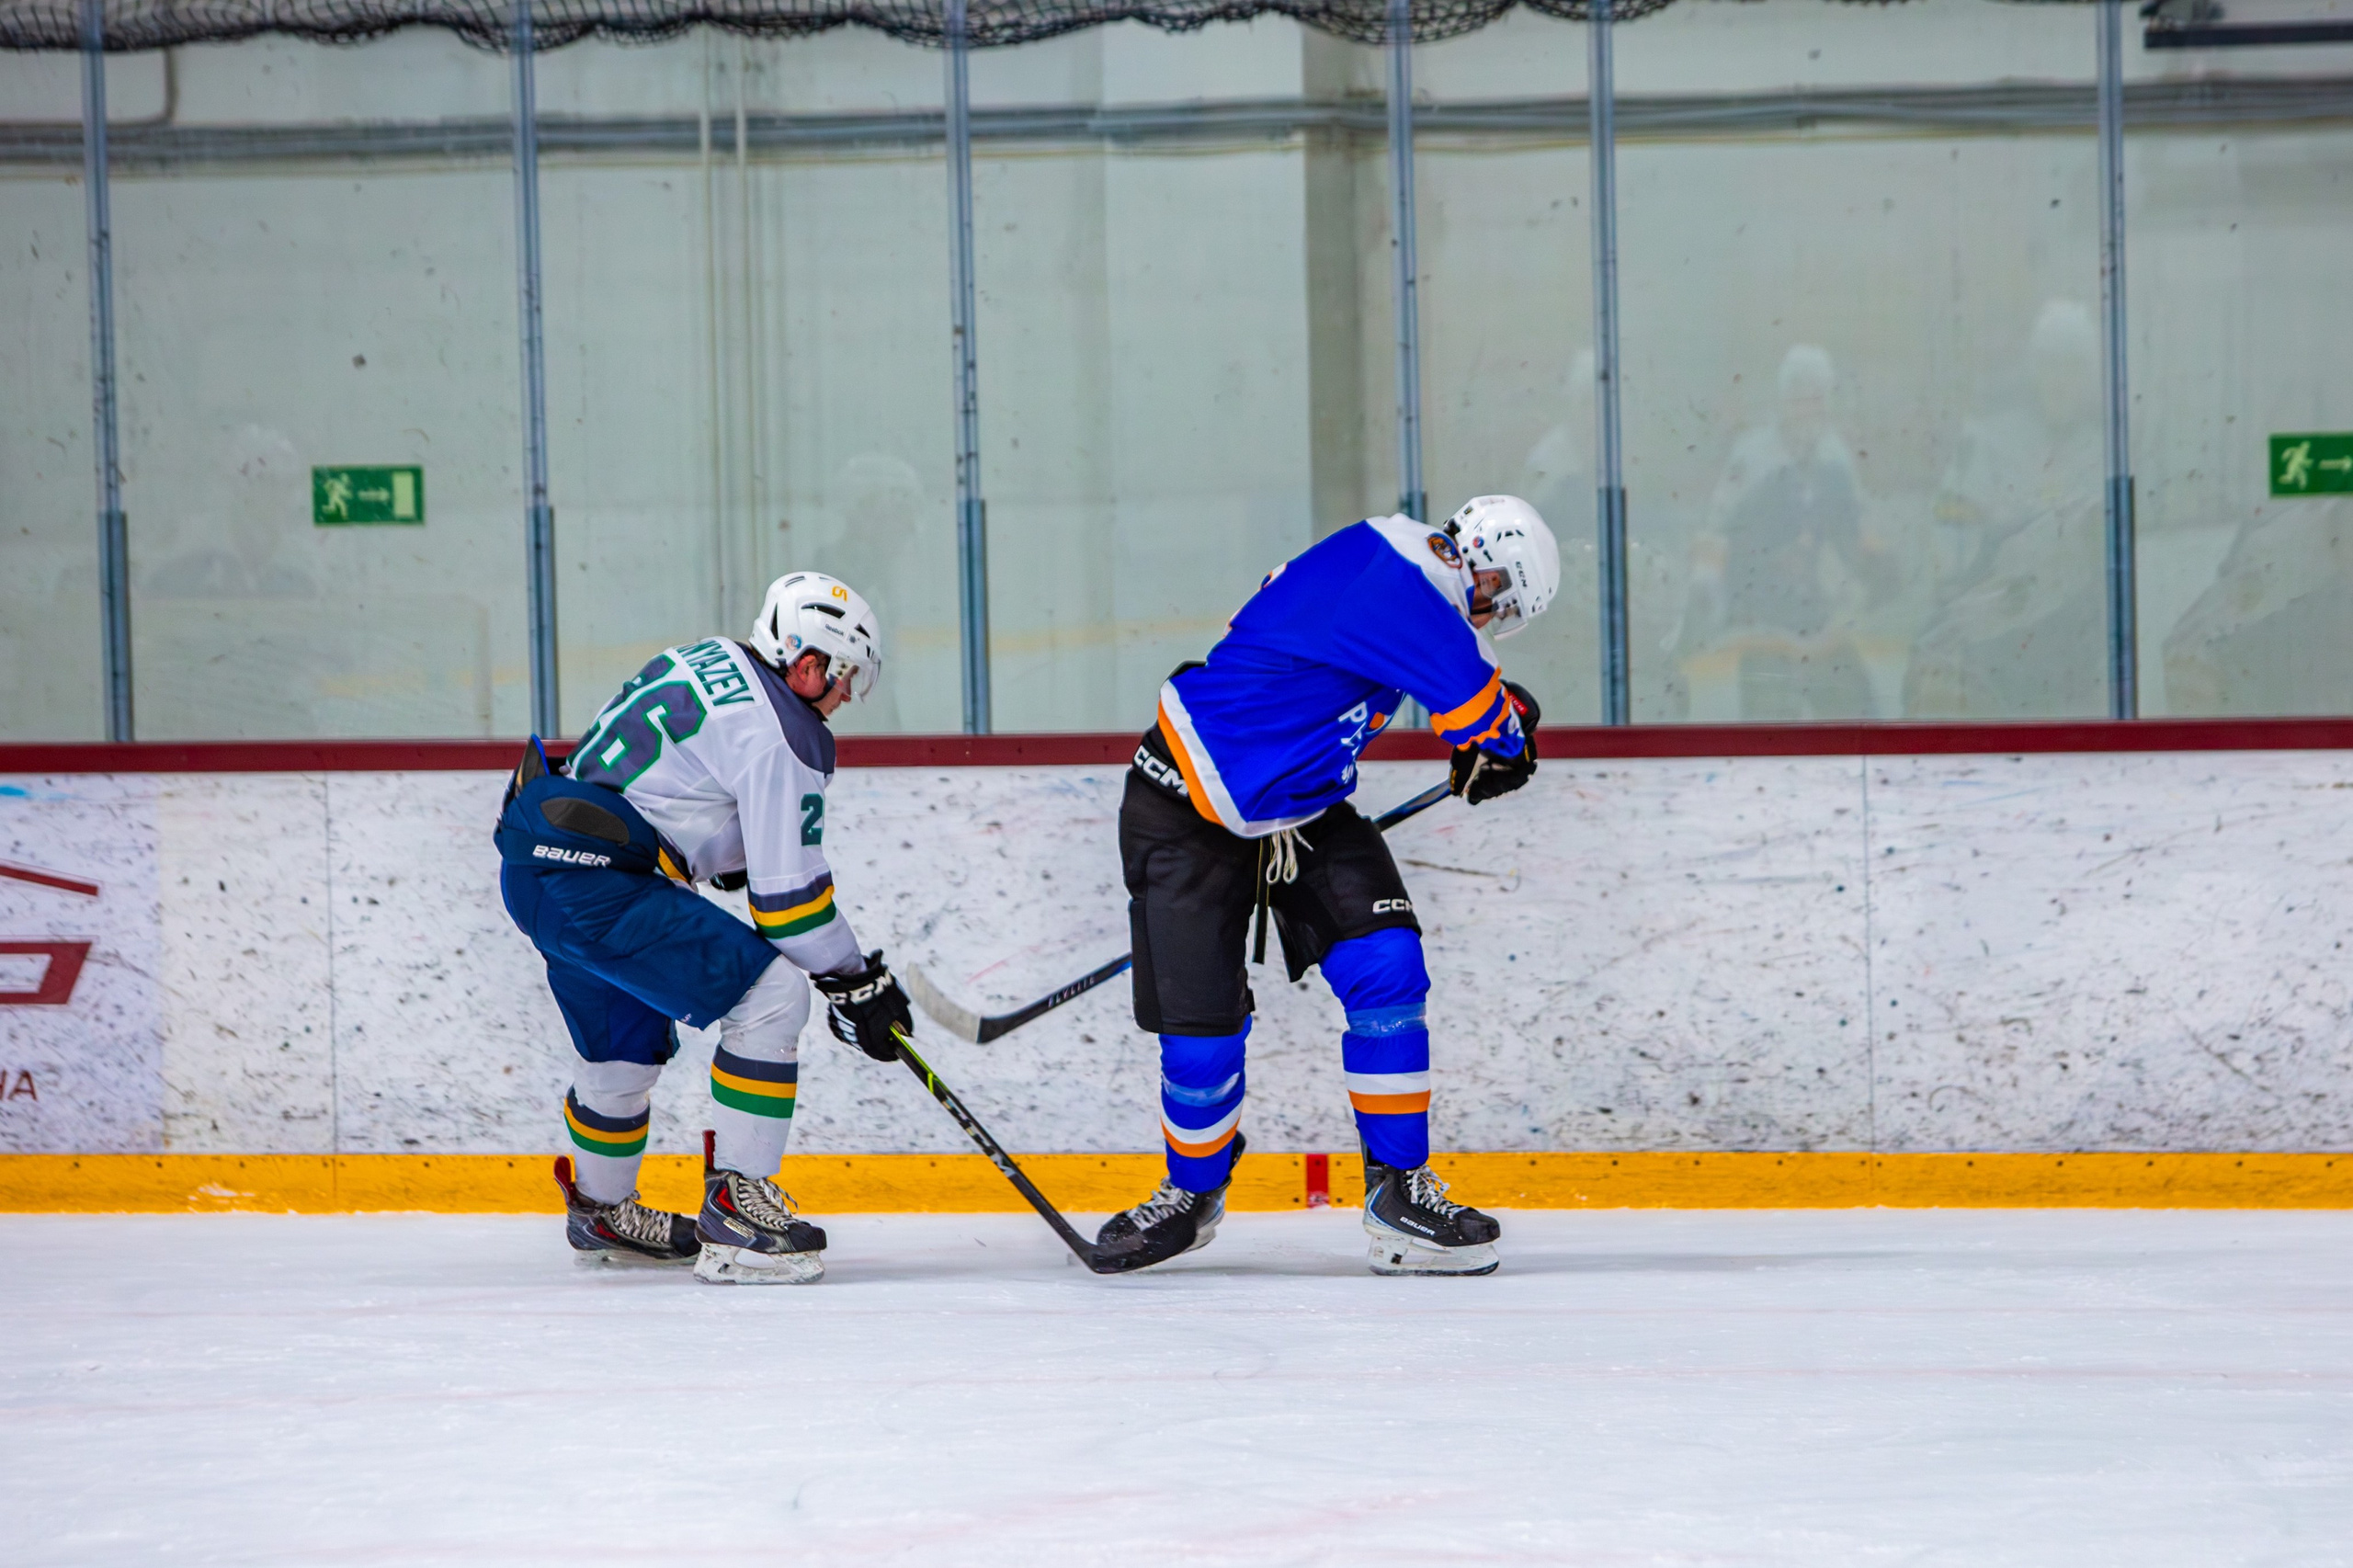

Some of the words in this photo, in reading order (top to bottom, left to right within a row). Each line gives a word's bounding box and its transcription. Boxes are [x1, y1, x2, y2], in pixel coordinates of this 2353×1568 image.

[671, 640, 756, 707] NYAZEV
[1133, 744, 1189, 798] CCM
[801, 793, 824, 846] 2
[532, 845, 611, 868] BAUER
[827, 969, 893, 1006] CCM
[1400, 1216, 1436, 1237] BAUER
